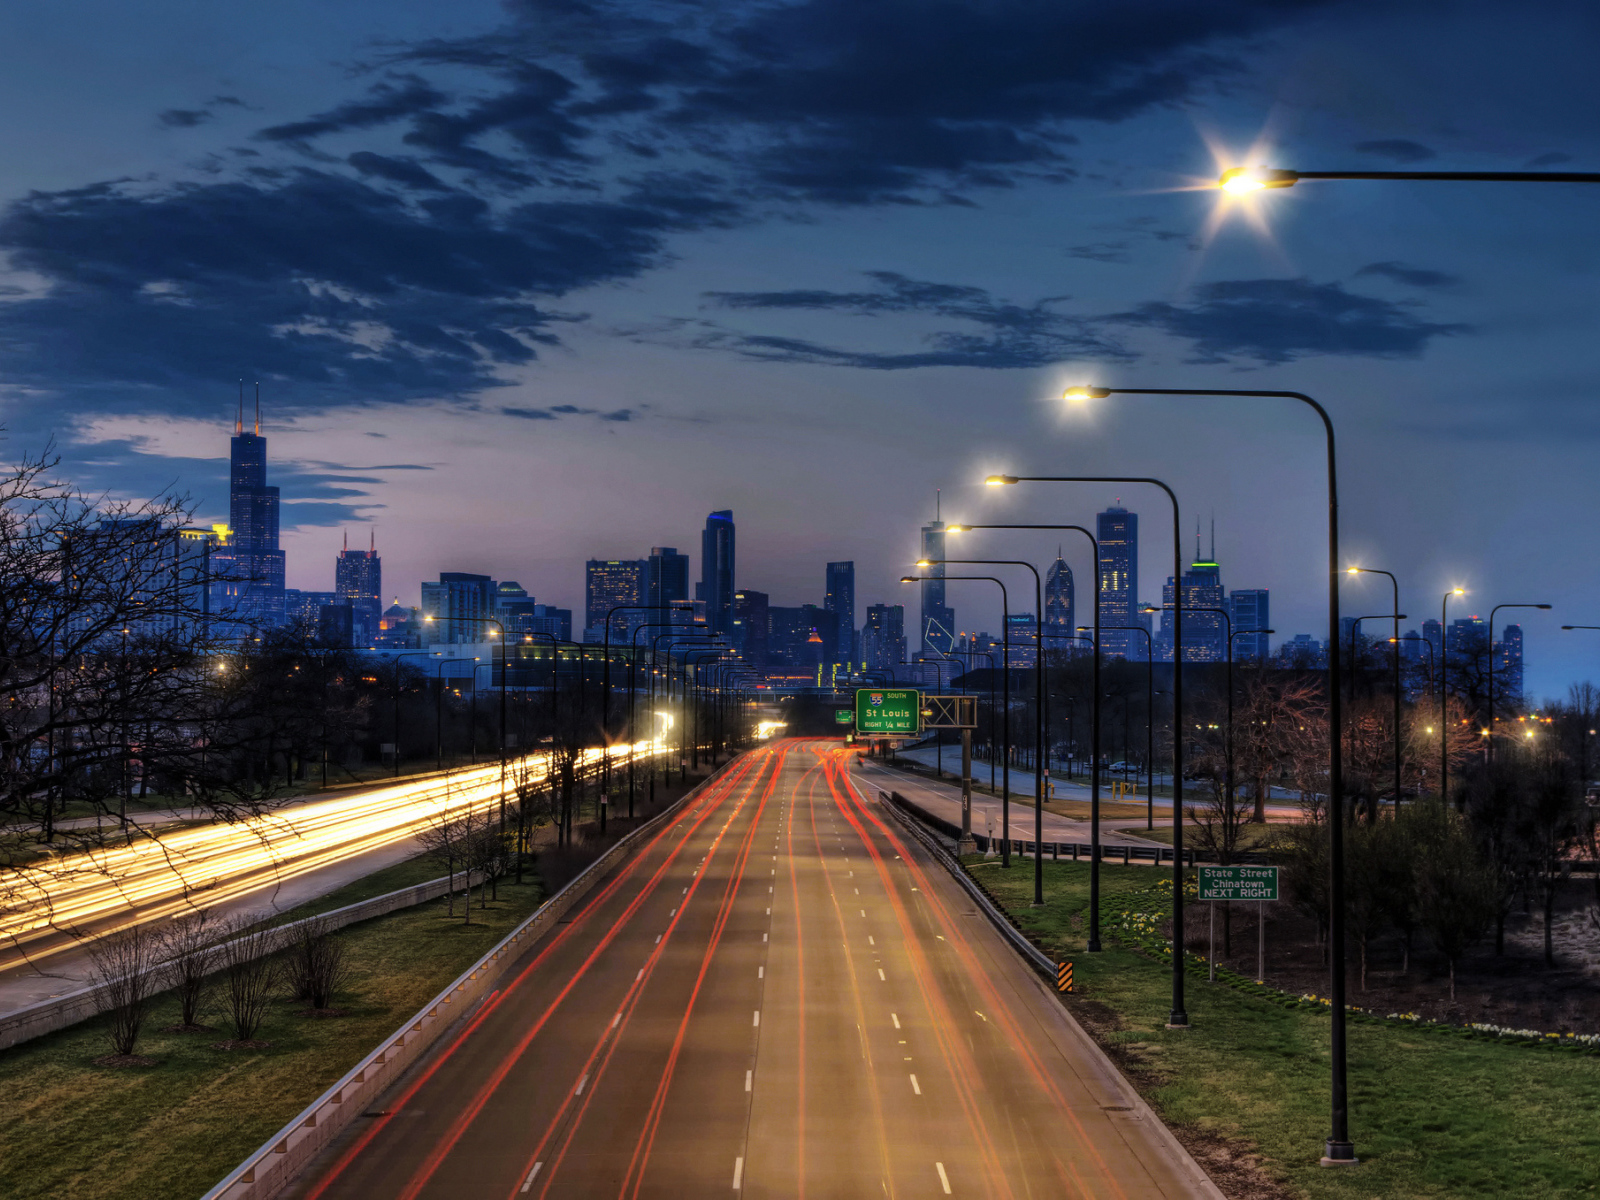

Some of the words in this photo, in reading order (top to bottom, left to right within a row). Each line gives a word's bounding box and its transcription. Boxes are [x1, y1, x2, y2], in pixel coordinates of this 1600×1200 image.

[1204, 869, 1233, 878] State
[1240, 869, 1272, 878] Street
[1212, 879, 1264, 888] Chinatown
[1204, 889, 1233, 897] NEXT
[1240, 889, 1272, 897] RIGHT
